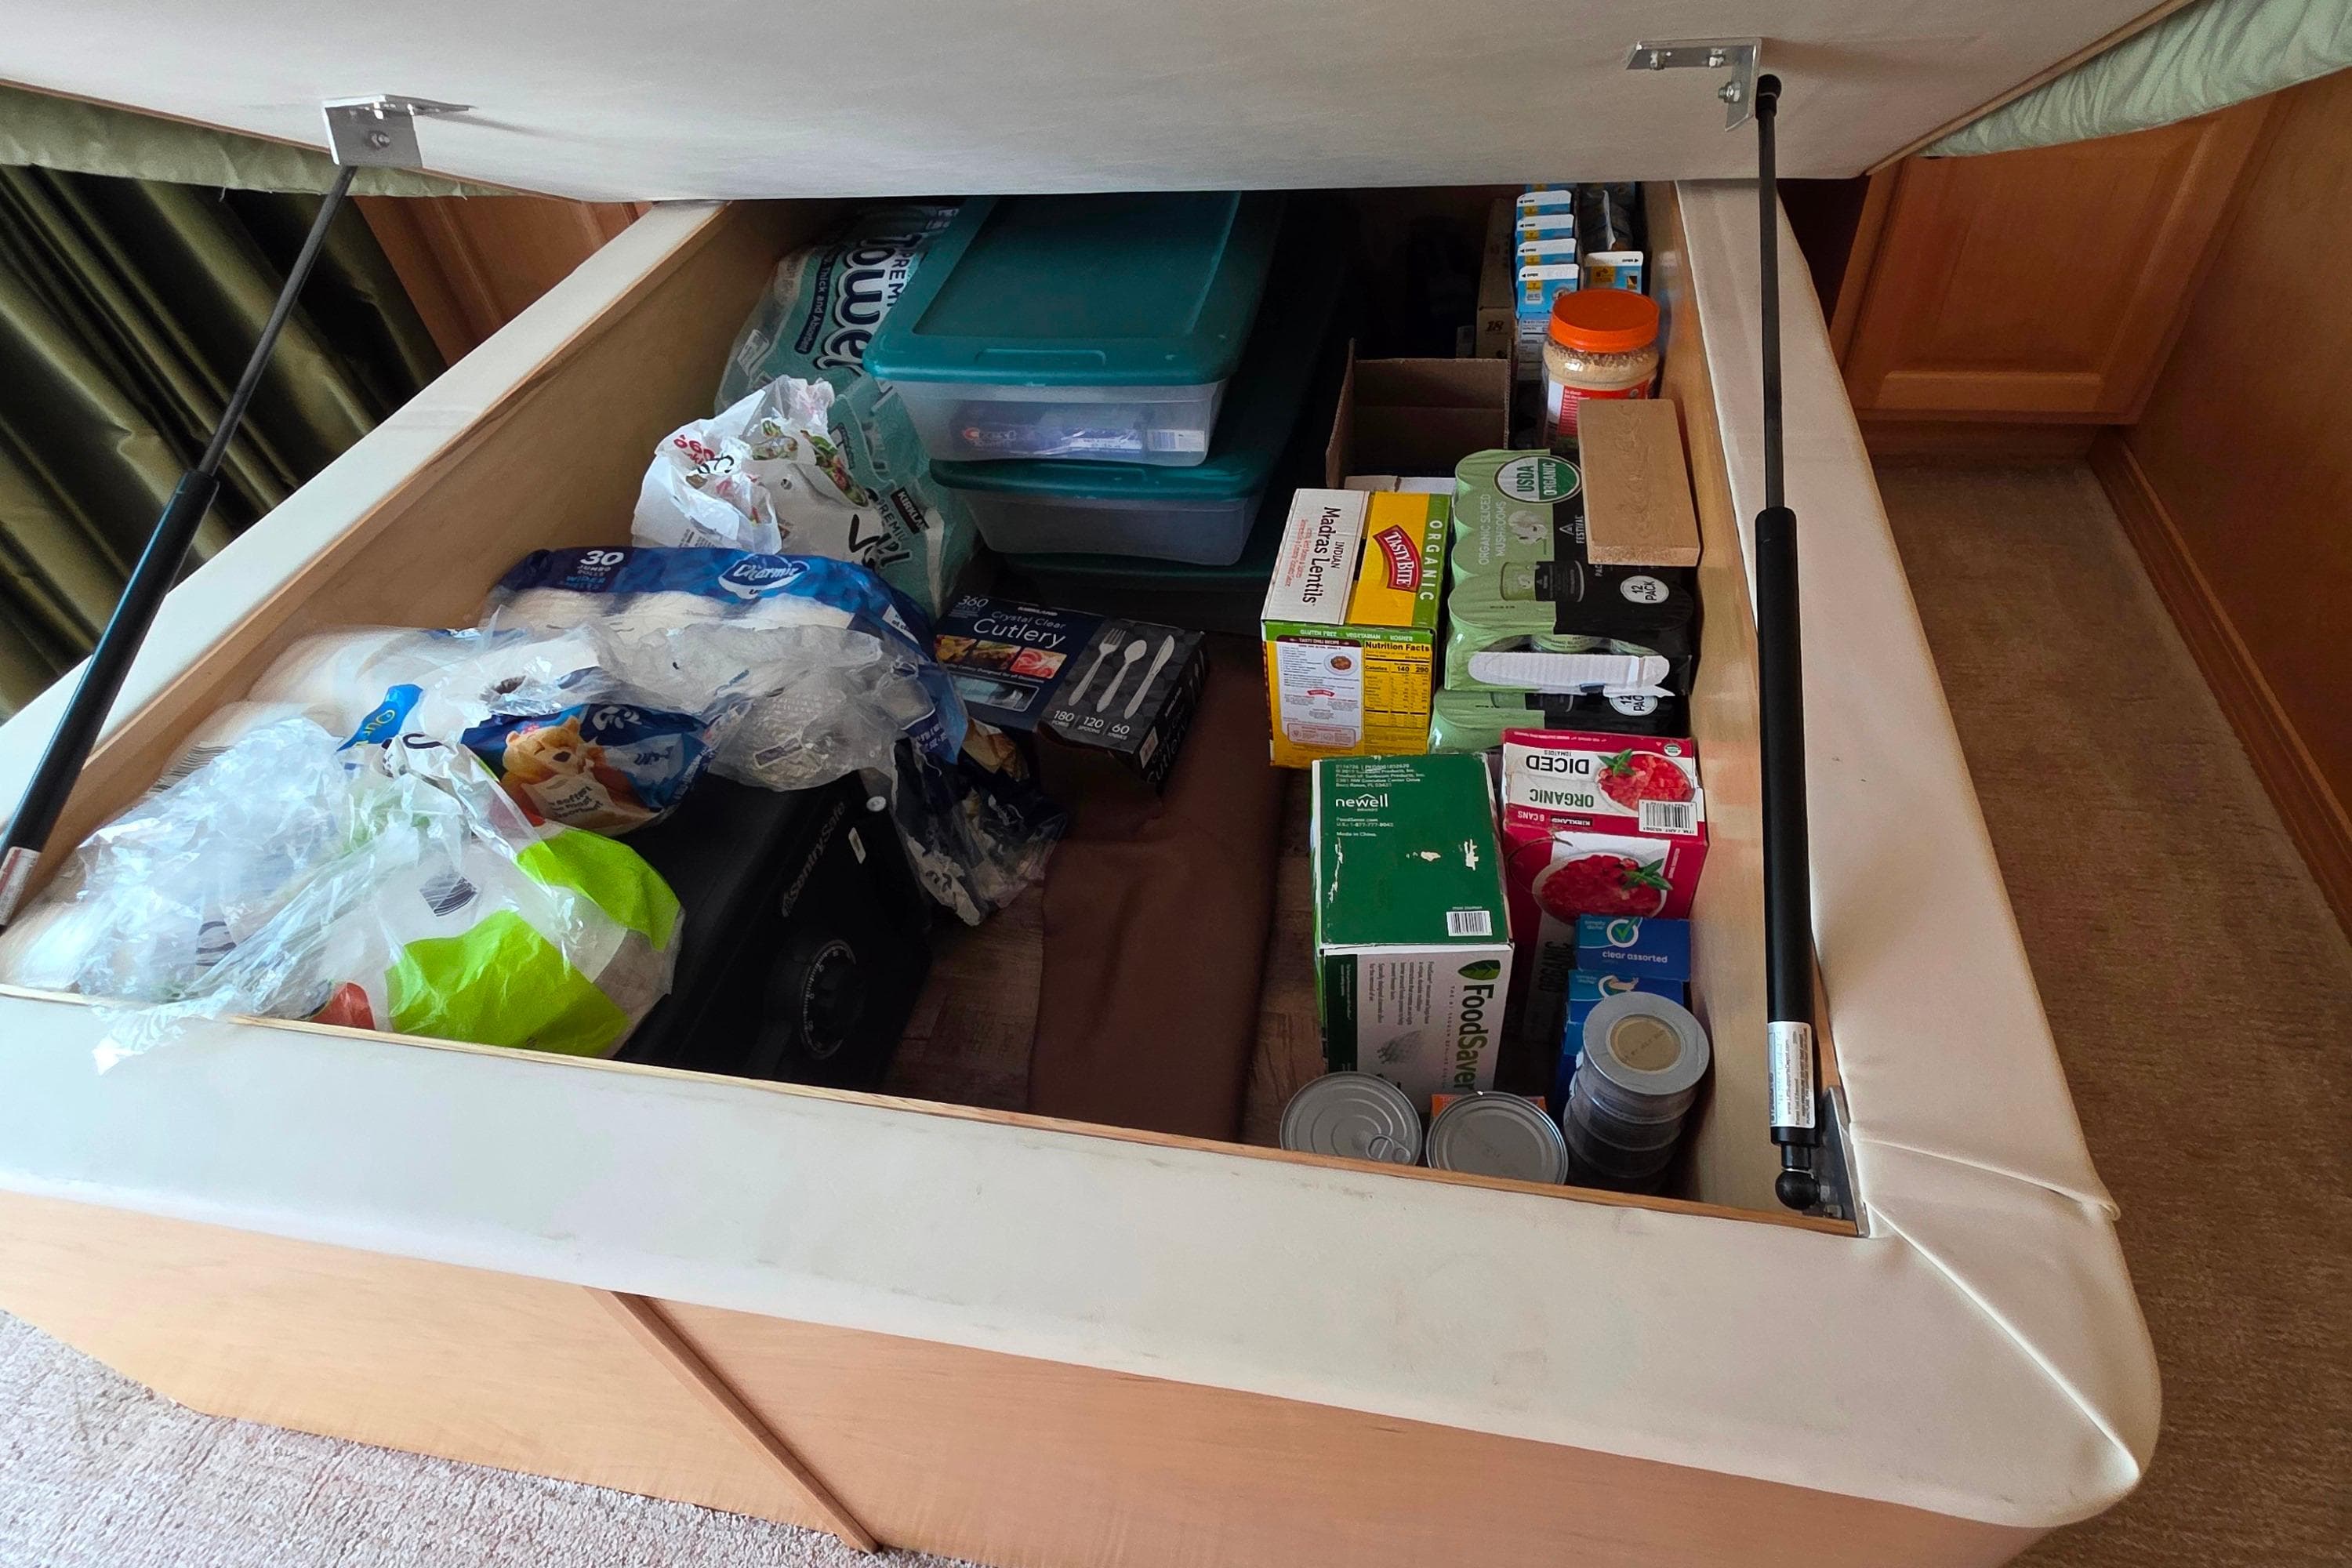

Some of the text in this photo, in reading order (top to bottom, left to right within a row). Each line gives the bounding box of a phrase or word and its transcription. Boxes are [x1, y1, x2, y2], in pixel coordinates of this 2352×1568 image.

[814, 296, 825, 314] and
[798, 315, 821, 353] Absorbent
[1486, 320, 1504, 332] 18
[1516, 466, 1535, 492] USDA
[1542, 463, 1557, 495] ORGANIC
[1479, 494, 1491, 565] ORGANIC SLICED
[1495, 501, 1507, 557] MUSHROOMS
[1575, 514, 1585, 544] FESTIVAL
[580, 550, 624, 566] 30
[1302, 506, 1342, 604] Madras Lentils
[1331, 541, 1345, 569] INDIAN
[1420, 520, 1443, 601] ORGANIC
[733, 563, 799, 581] Charmin
[1631, 585, 1643, 594] 12
[1643, 580, 1657, 601] PACK
[957, 595, 989, 608] 360
[991, 611, 1033, 624] Crystal
[1035, 617, 1066, 629] Clear
[973, 618, 1066, 649] Cutlery
[1365, 641, 1430, 652] Nutrition Facts
[1632, 695, 1645, 712] PAC
[1053, 710, 1076, 723] 180
[1083, 716, 1104, 728] 120
[1077, 726, 1101, 735] SPOONS
[1112, 724, 1131, 735] 60
[1526, 754, 1589, 775] DICED
[1336, 793, 1388, 808] newell
[1529, 788, 1595, 808] ORGANIC
[1518, 811, 1539, 821] CANS
[1602, 950, 1668, 963] clear assorted
[1454, 984, 1494, 1092] FoodSaver
